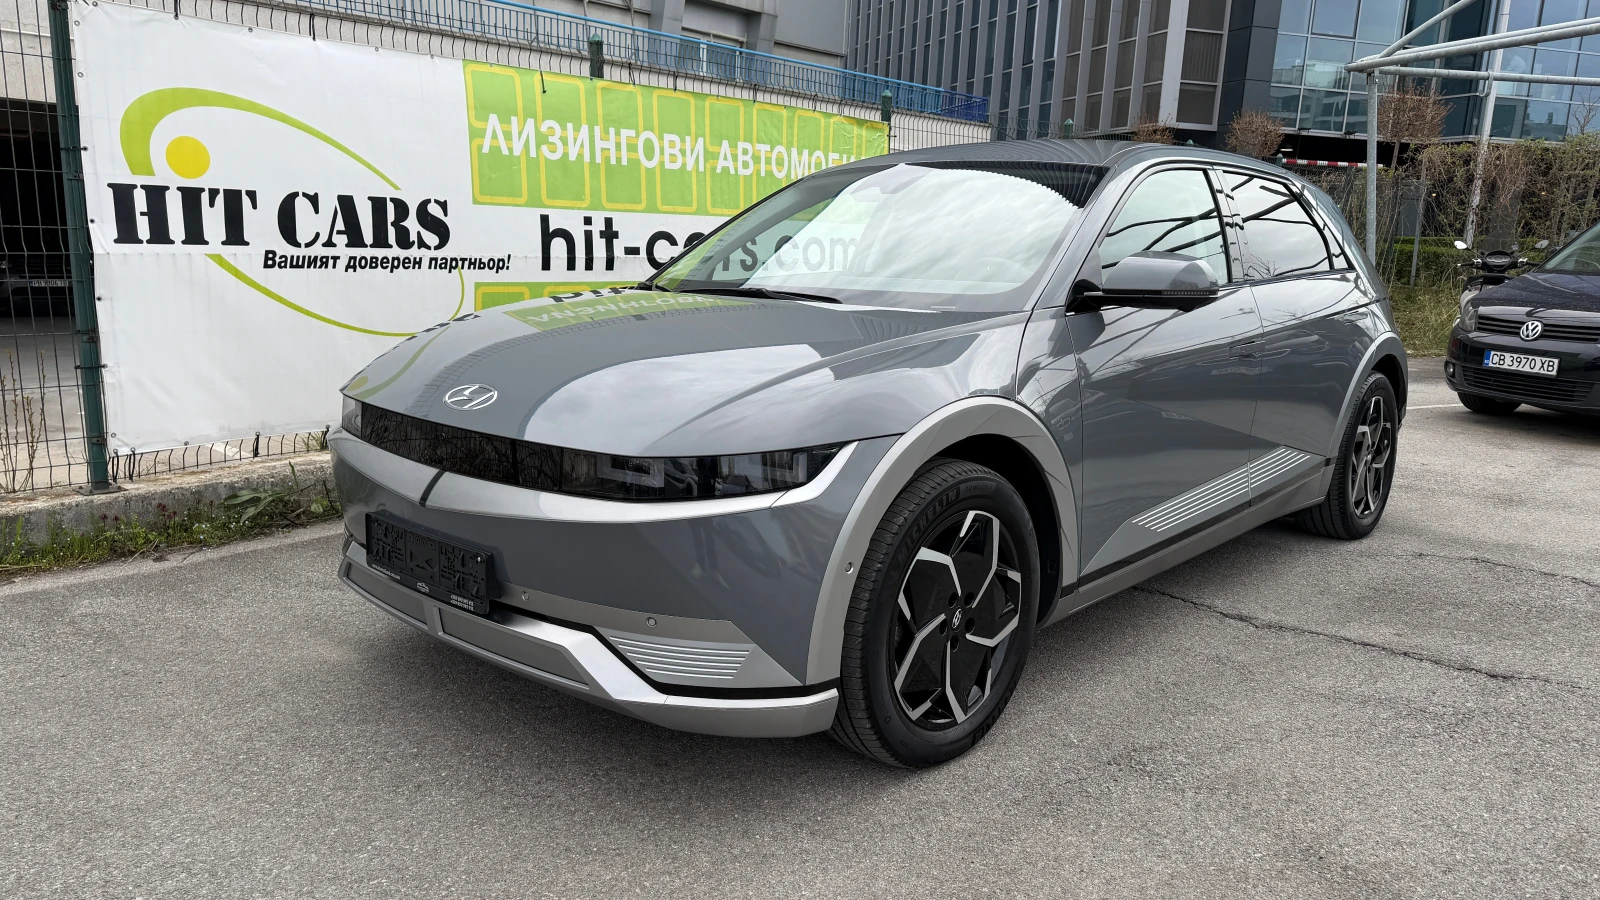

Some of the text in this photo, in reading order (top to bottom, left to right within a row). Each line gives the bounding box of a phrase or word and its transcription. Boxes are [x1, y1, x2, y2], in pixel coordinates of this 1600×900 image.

[482, 113, 866, 180] ЛИЗИНГОВИ АВТОМО
[106, 182, 451, 252] HIT CARS
[262, 249, 512, 275] Вашият доверен партньор!
[1491, 353, 1555, 372] CB 3970 XB
